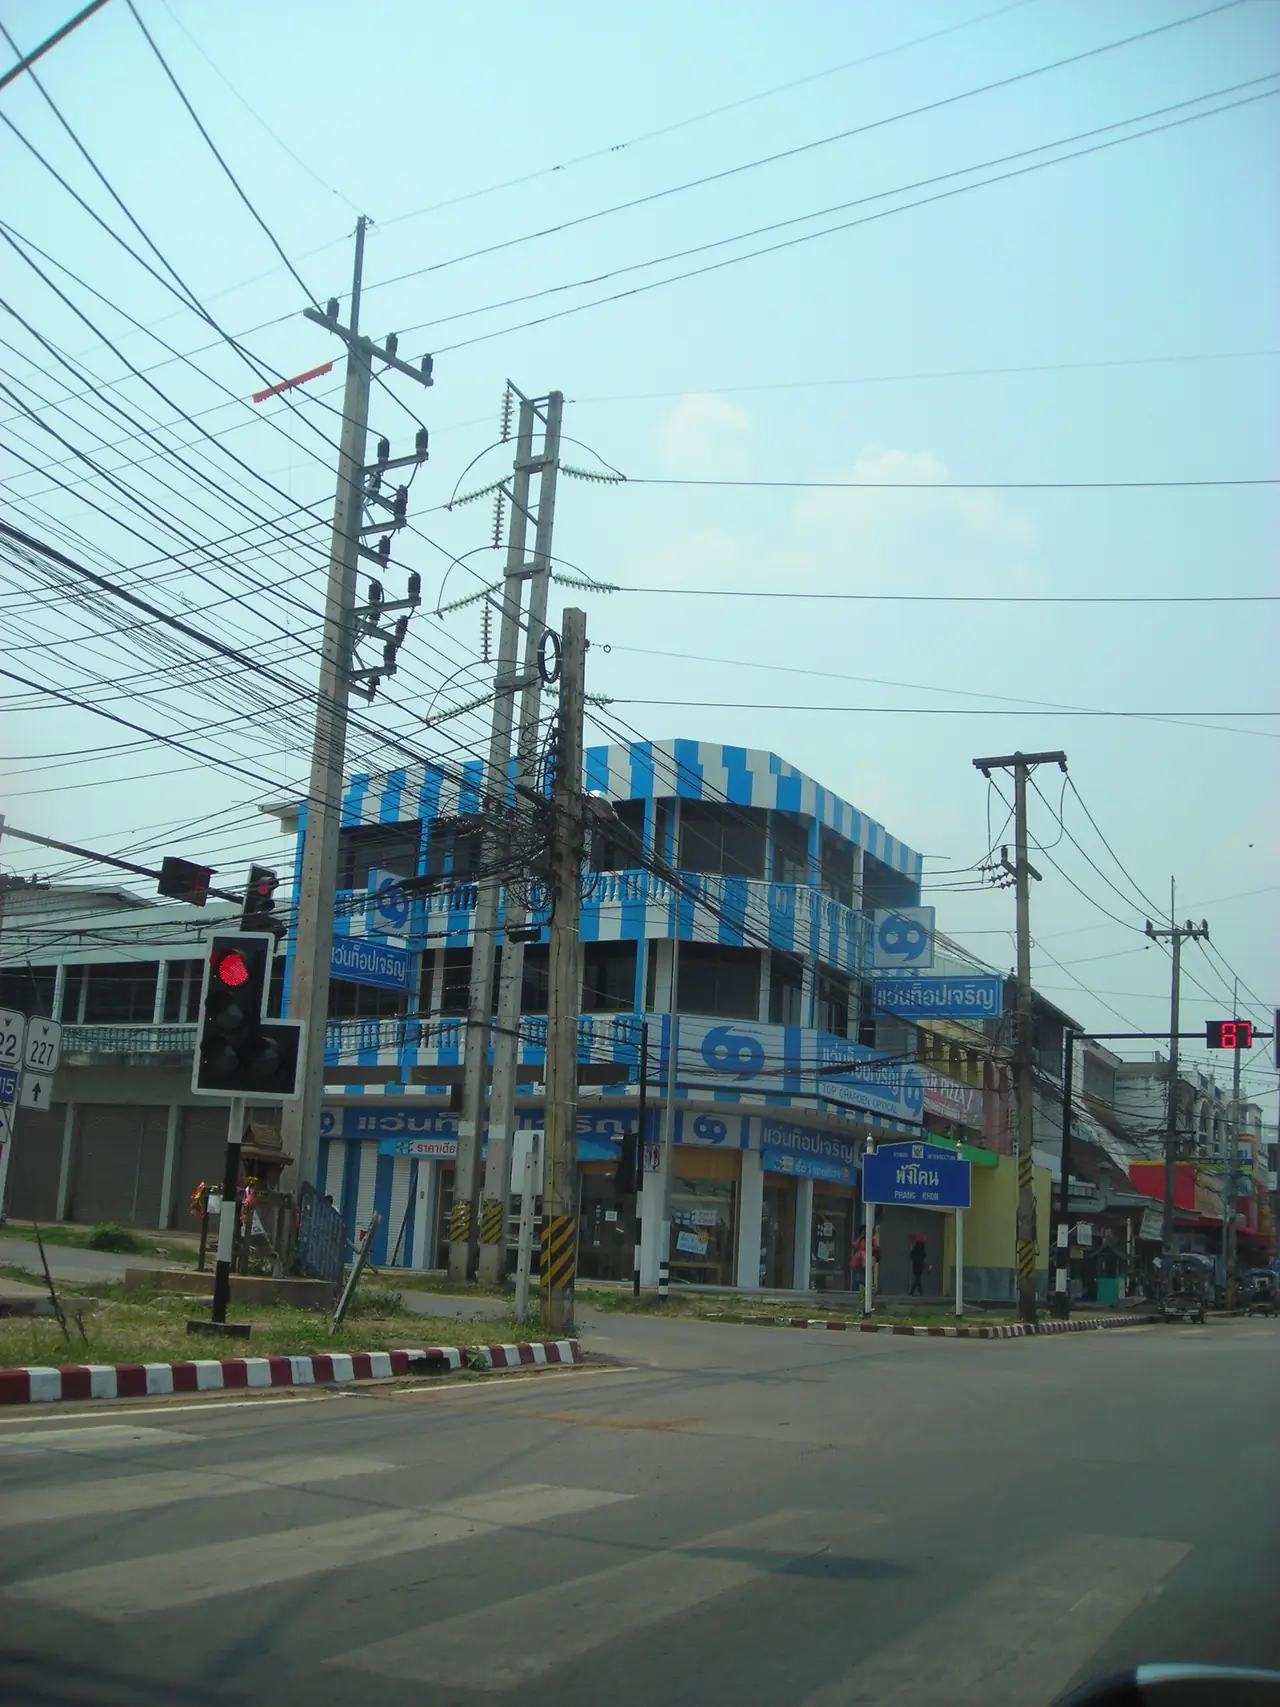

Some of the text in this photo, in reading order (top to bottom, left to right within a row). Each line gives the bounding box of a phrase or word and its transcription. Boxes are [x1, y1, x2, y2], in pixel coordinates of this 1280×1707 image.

[877, 983, 994, 1010] แว่นท็อปเจริญ
[1221, 1022, 1251, 1048] 87
[30, 1040, 55, 1066] 227
[822, 1042, 899, 1096] แว่นท็อปเจรญ
[940, 1077, 965, 1105] PIZZA
[417, 1141, 459, 1154] ราคาเดีย
[763, 1126, 853, 1162] แว่นท็อปเจริญ
[895, 1163, 939, 1186] พังโคน
